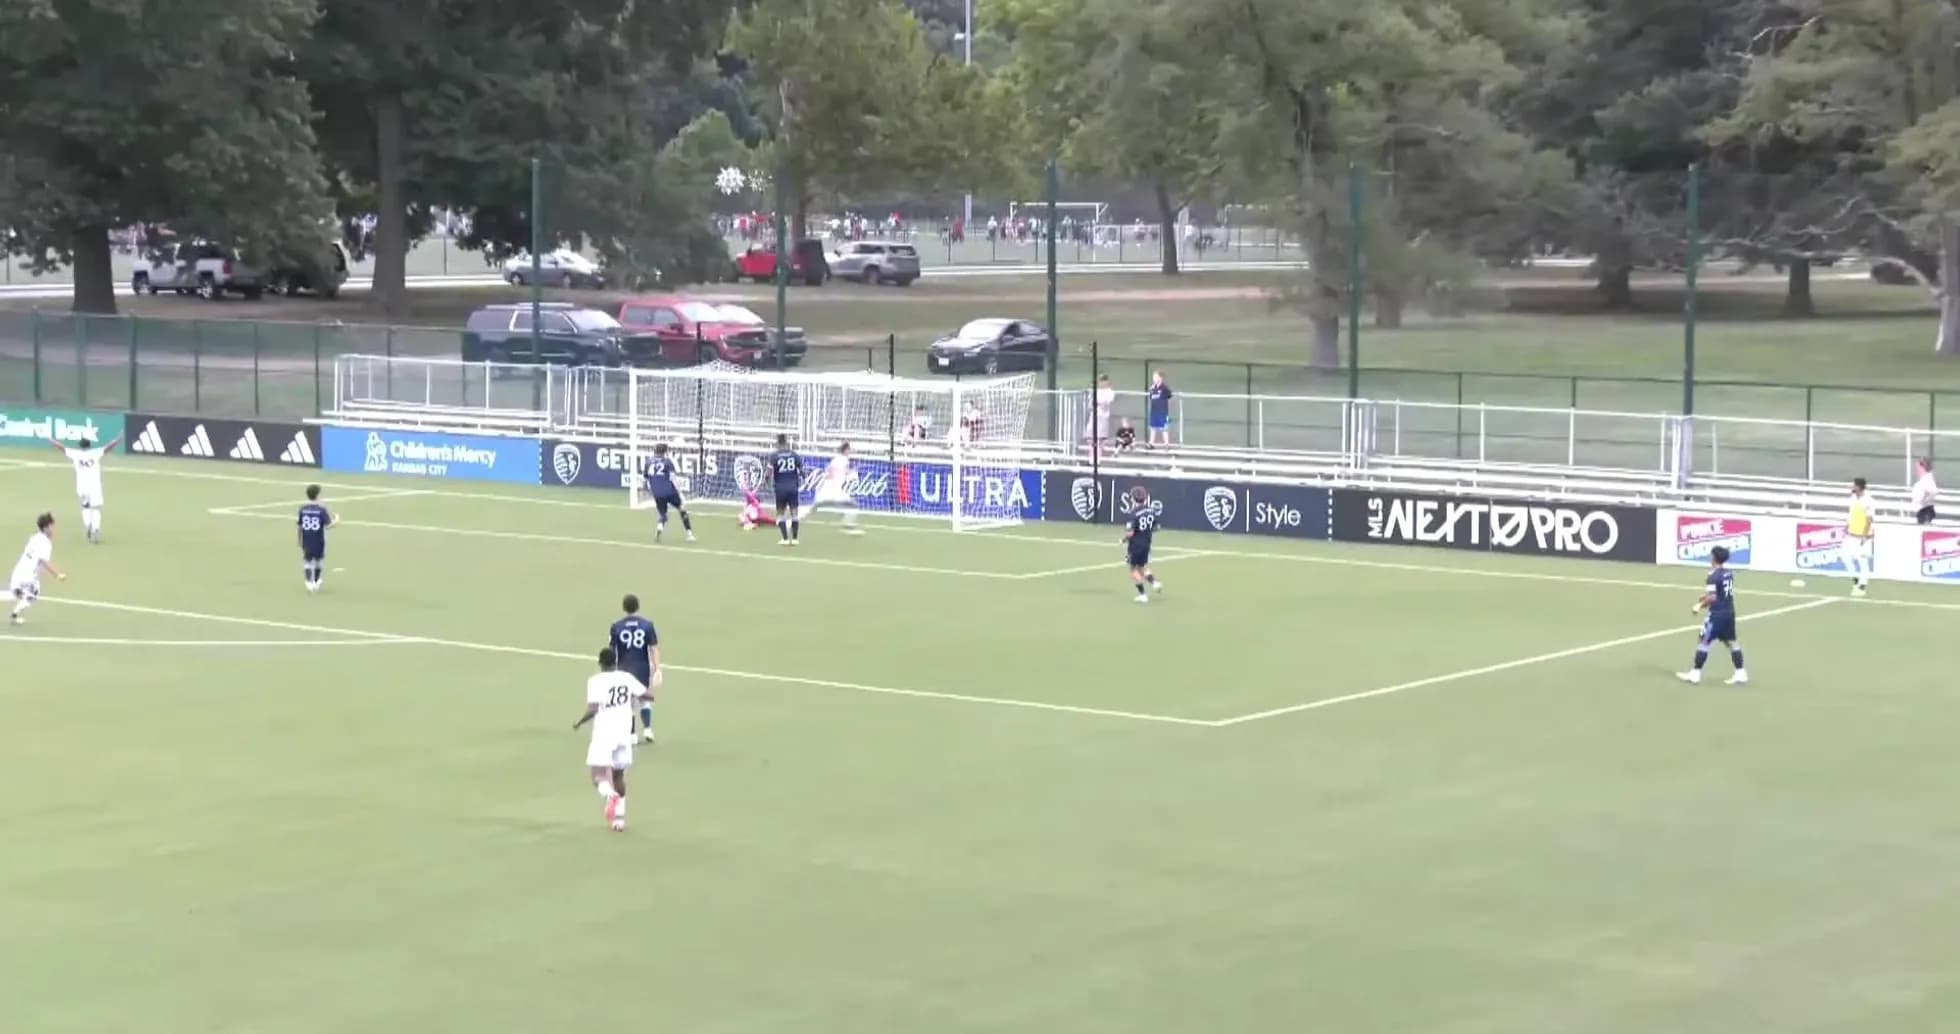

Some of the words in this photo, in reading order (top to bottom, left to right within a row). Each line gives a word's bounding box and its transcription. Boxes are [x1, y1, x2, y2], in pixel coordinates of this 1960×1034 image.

[54, 417, 99, 442] Bank
[454, 445, 497, 468] Mercy
[596, 448, 631, 470] GET
[636, 449, 718, 475] TKETS
[777, 457, 796, 472] 28
[648, 462, 665, 476] 42
[798, 466, 891, 498] Melob
[920, 471, 1029, 508] ULTRA
[1120, 492, 1163, 517] Sle
[1255, 502, 1301, 529] Style
[302, 515, 320, 531] 88
[1139, 514, 1154, 530] 89
[1368, 497, 1383, 538] MLS
[620, 628, 645, 649] 98
[605, 685, 628, 708] 18
